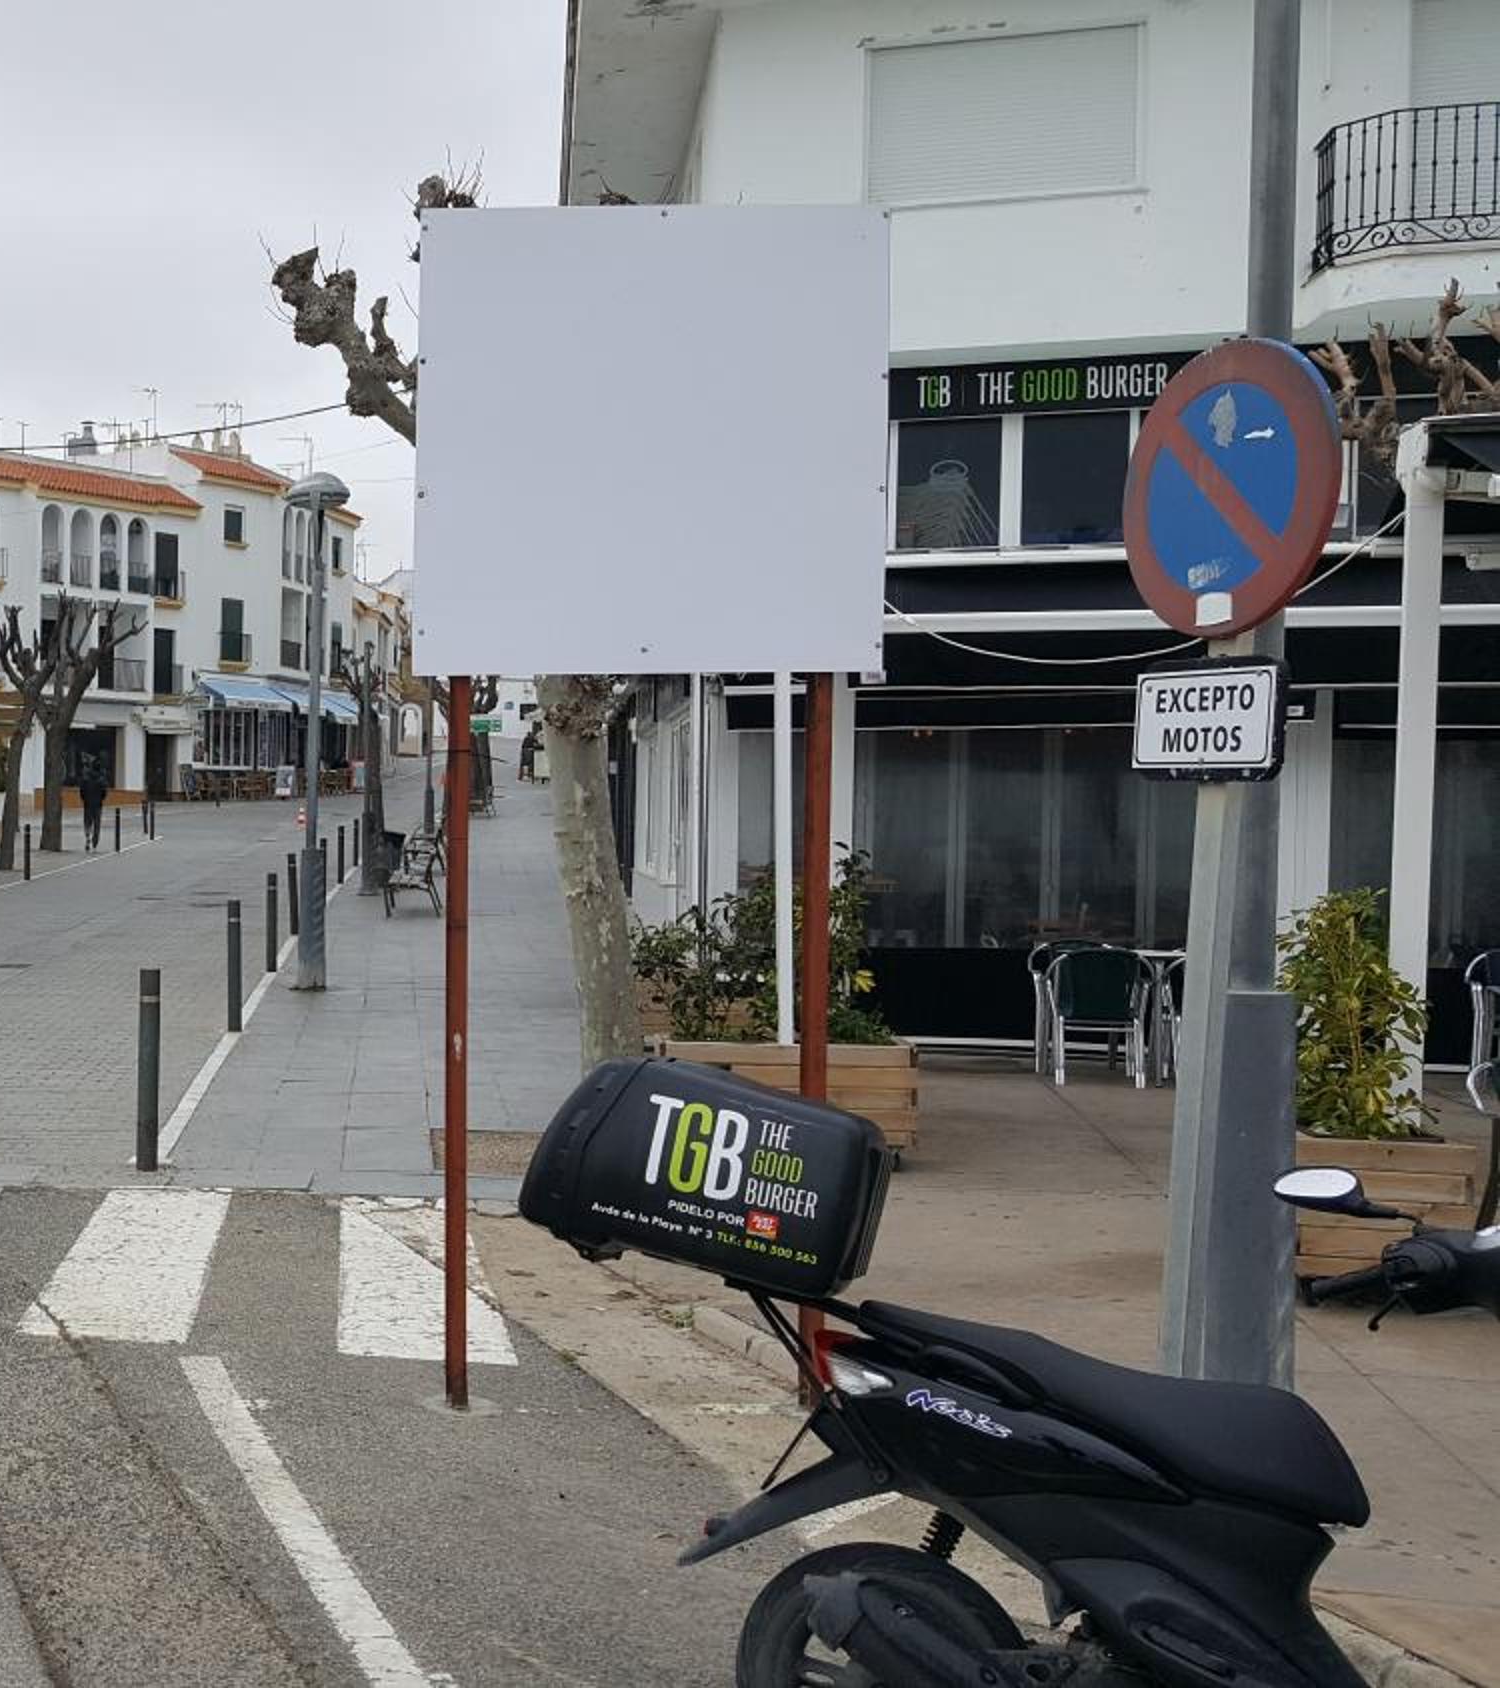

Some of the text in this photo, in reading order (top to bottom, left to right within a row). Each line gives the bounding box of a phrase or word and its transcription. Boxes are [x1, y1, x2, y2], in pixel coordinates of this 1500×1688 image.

[916, 375, 951, 409] TGB
[977, 362, 1168, 405] THE GOOD BURGER
[1155, 683, 1256, 714] EXCEPTO
[1161, 725, 1243, 754] MOTOS
[644, 1093, 749, 1201] TGB
[760, 1119, 796, 1151] THE
[751, 1149, 804, 1184] GOOD
[667, 1199, 745, 1227] PIDELO POR
[743, 1177, 819, 1220] BURGER
[621, 1210, 636, 1221] de
[638, 1213, 650, 1224] la
[705, 1229, 713, 1239] 3
[769, 1244, 793, 1259] 500
